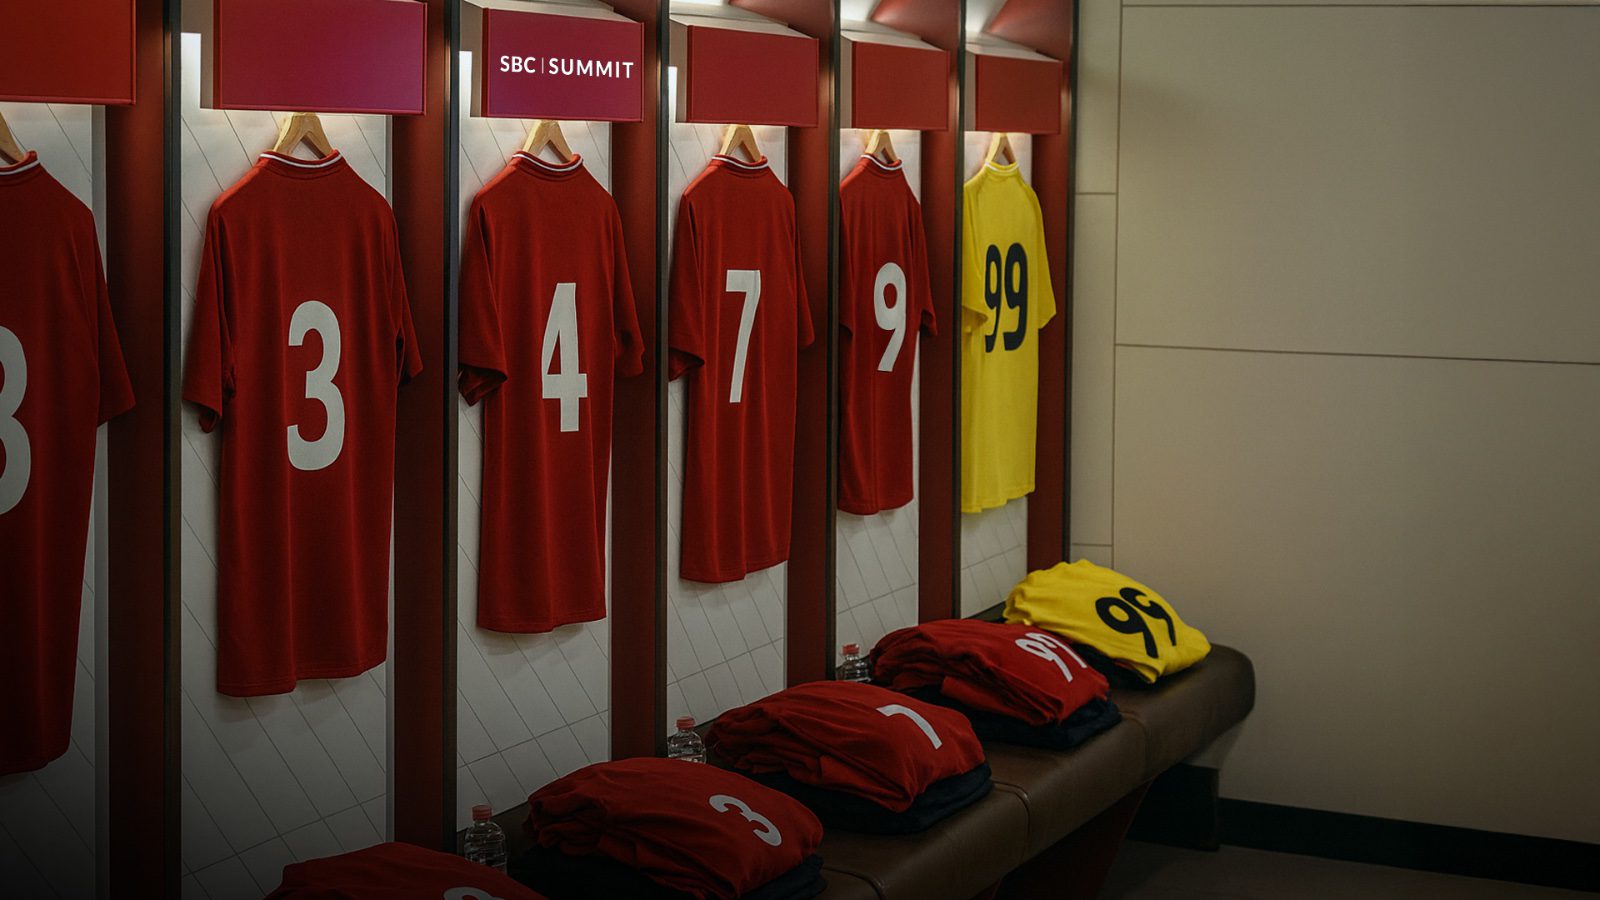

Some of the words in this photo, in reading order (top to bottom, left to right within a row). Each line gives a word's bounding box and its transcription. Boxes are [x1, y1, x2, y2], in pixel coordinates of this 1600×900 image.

[500, 55, 536, 74] SBC
[548, 57, 634, 79] SUMMIT
[725, 269, 762, 403] 7
[873, 261, 907, 372] 9
[985, 242, 1028, 353] 99
[286, 300, 346, 471] 3
[541, 282, 588, 433] 4
[875, 703, 943, 750] 7
[708, 794, 782, 847] 3
